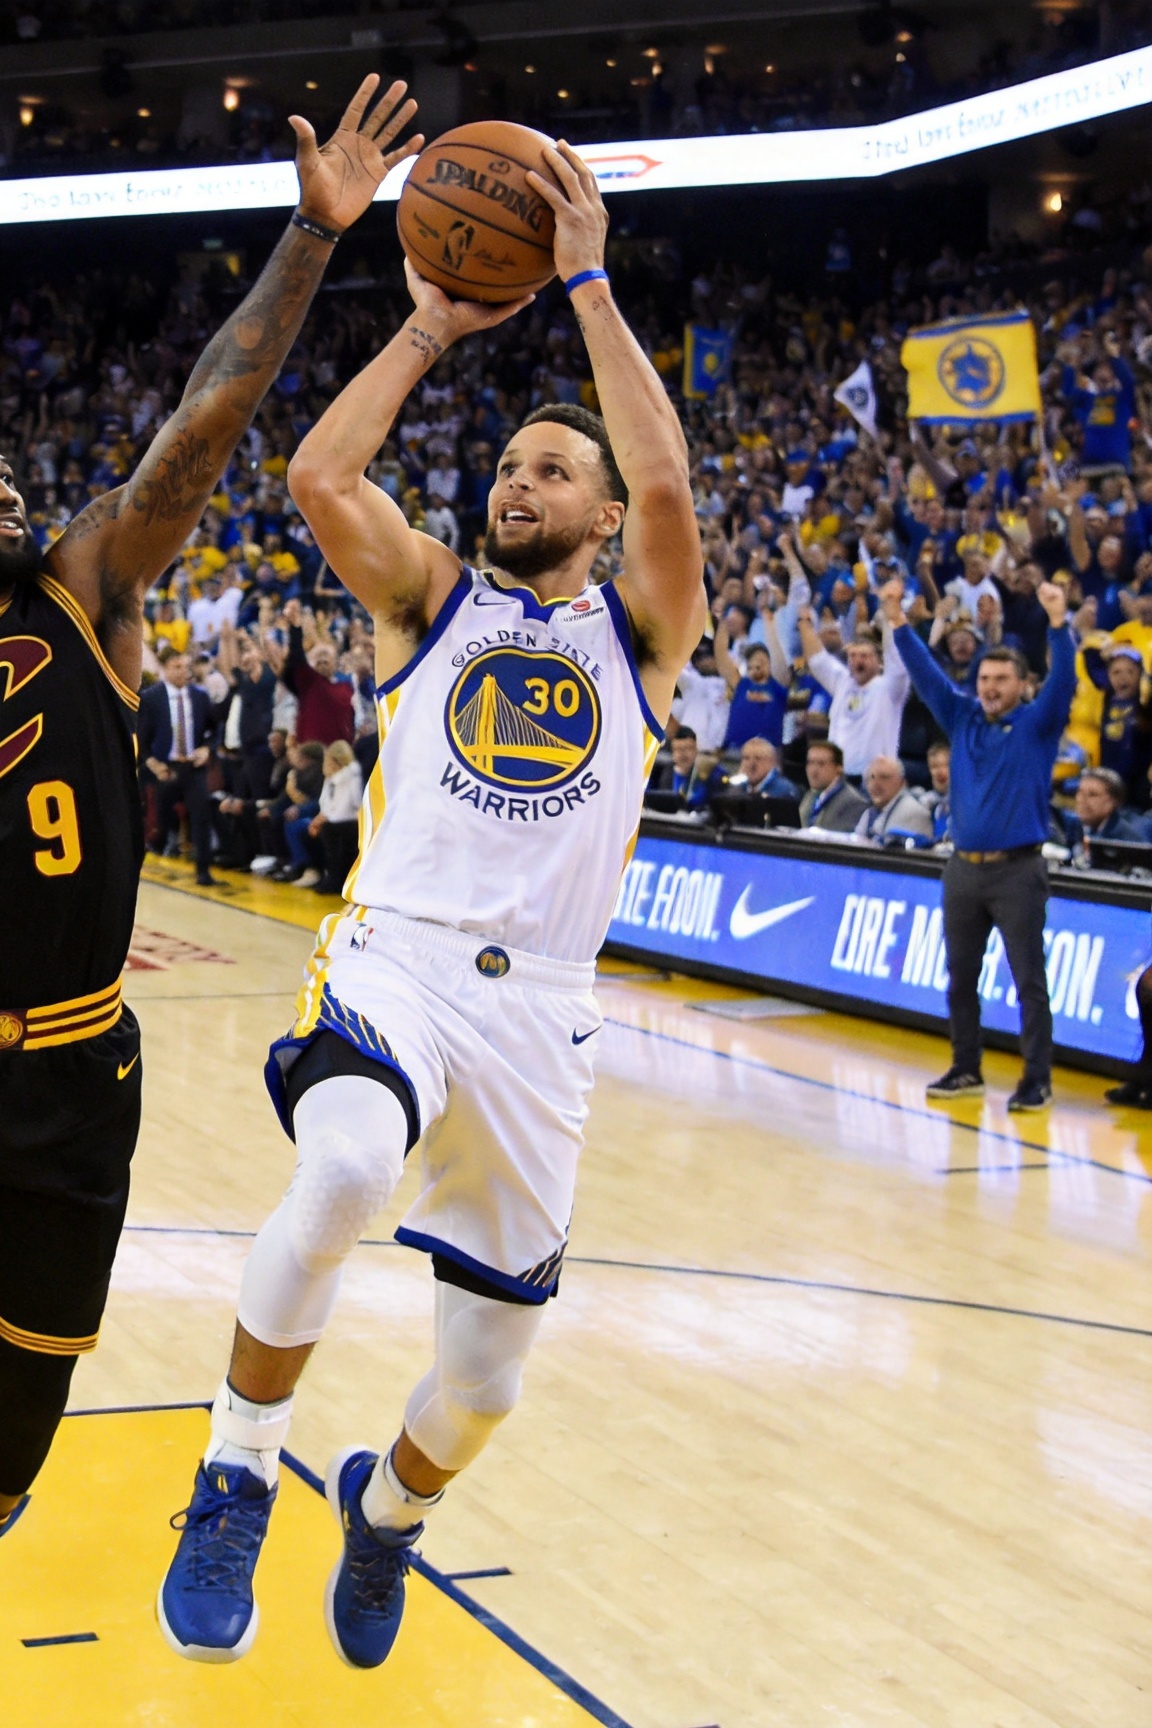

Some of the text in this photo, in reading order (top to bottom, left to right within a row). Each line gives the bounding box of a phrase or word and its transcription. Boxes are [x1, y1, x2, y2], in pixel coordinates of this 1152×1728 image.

[452, 630, 537, 667] GOLDEN
[522, 677, 580, 718] 30
[439, 761, 602, 822] WARRIORS
[27, 780, 81, 877] 9
